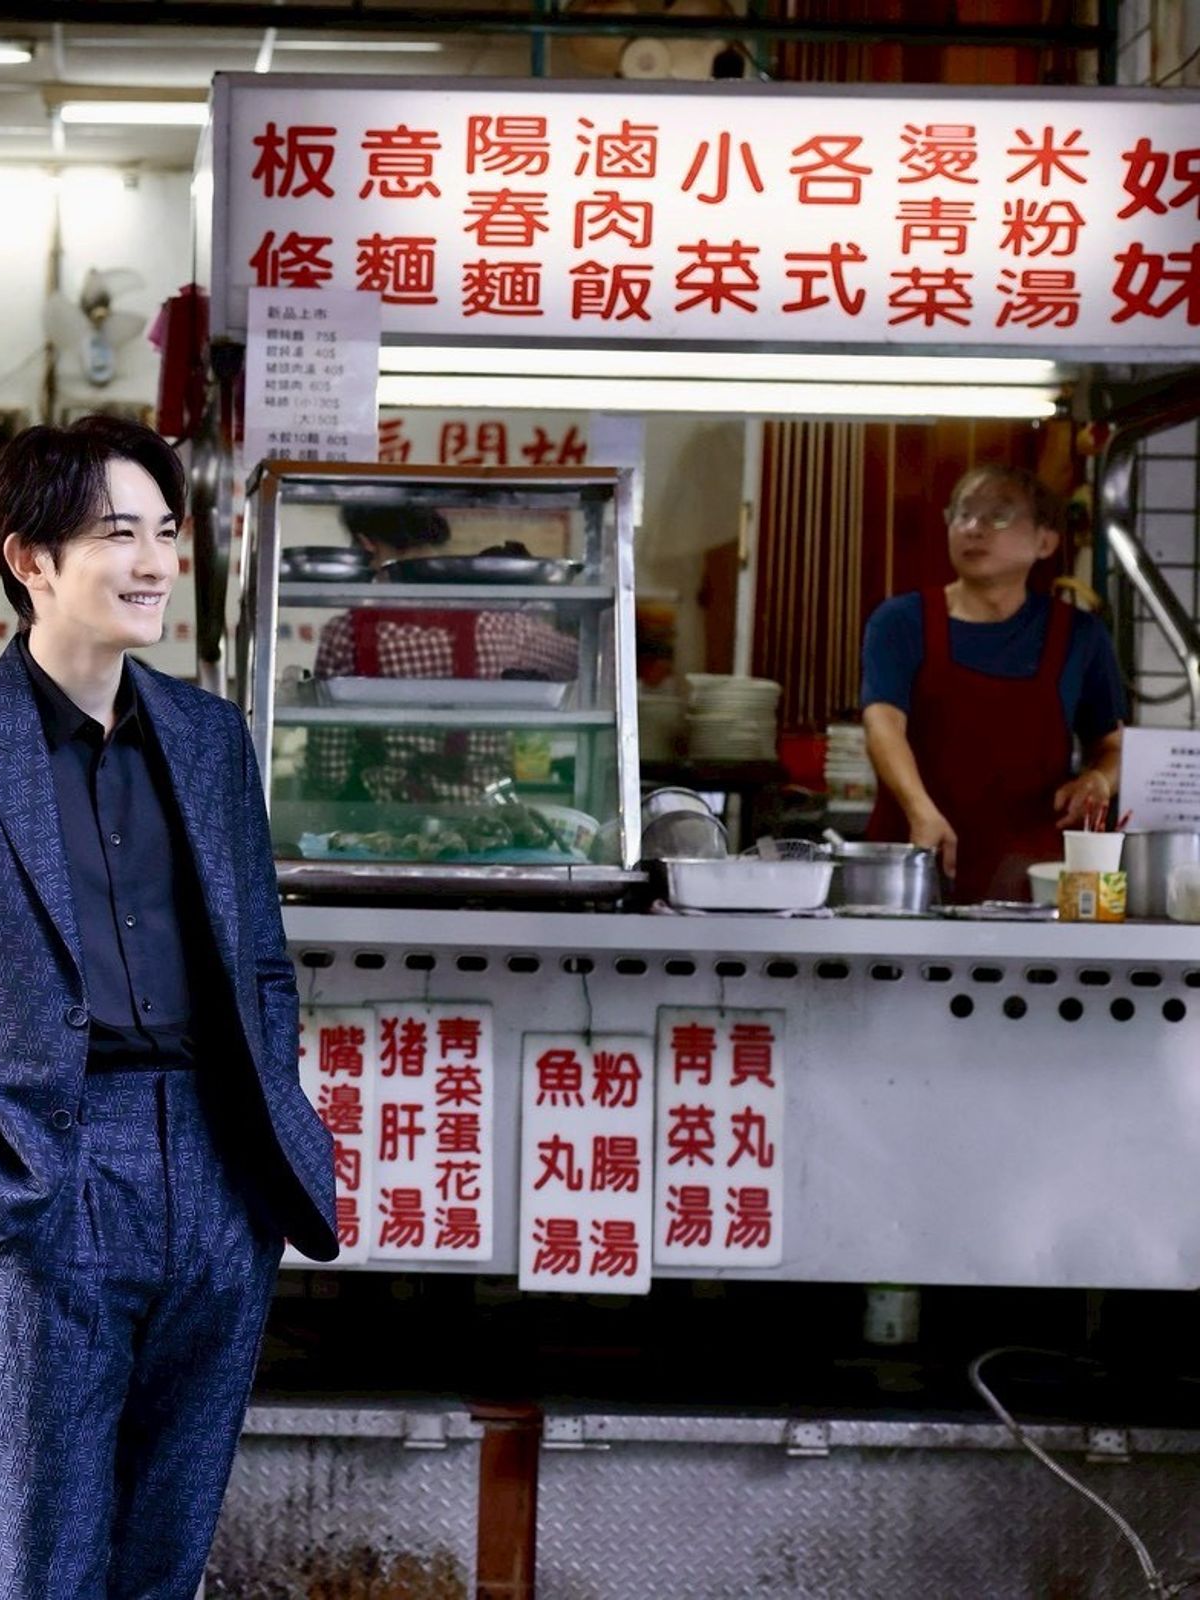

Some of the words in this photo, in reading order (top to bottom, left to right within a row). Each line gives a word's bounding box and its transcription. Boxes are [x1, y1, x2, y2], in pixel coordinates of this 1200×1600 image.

[355, 124, 443, 305] 意麵
[461, 115, 550, 317] 陽春麵
[568, 117, 659, 321] 滷肉飯
[674, 130, 765, 315] 小菜
[781, 134, 874, 317] 各式
[993, 125, 1091, 330] 米粉湯
[531, 1048, 585, 1276] 魚丸湯
[588, 1050, 643, 1279] 粉腸湯
[664, 1021, 718, 1248] 青菜湯
[724, 1023, 777, 1249] 貢丸湯
